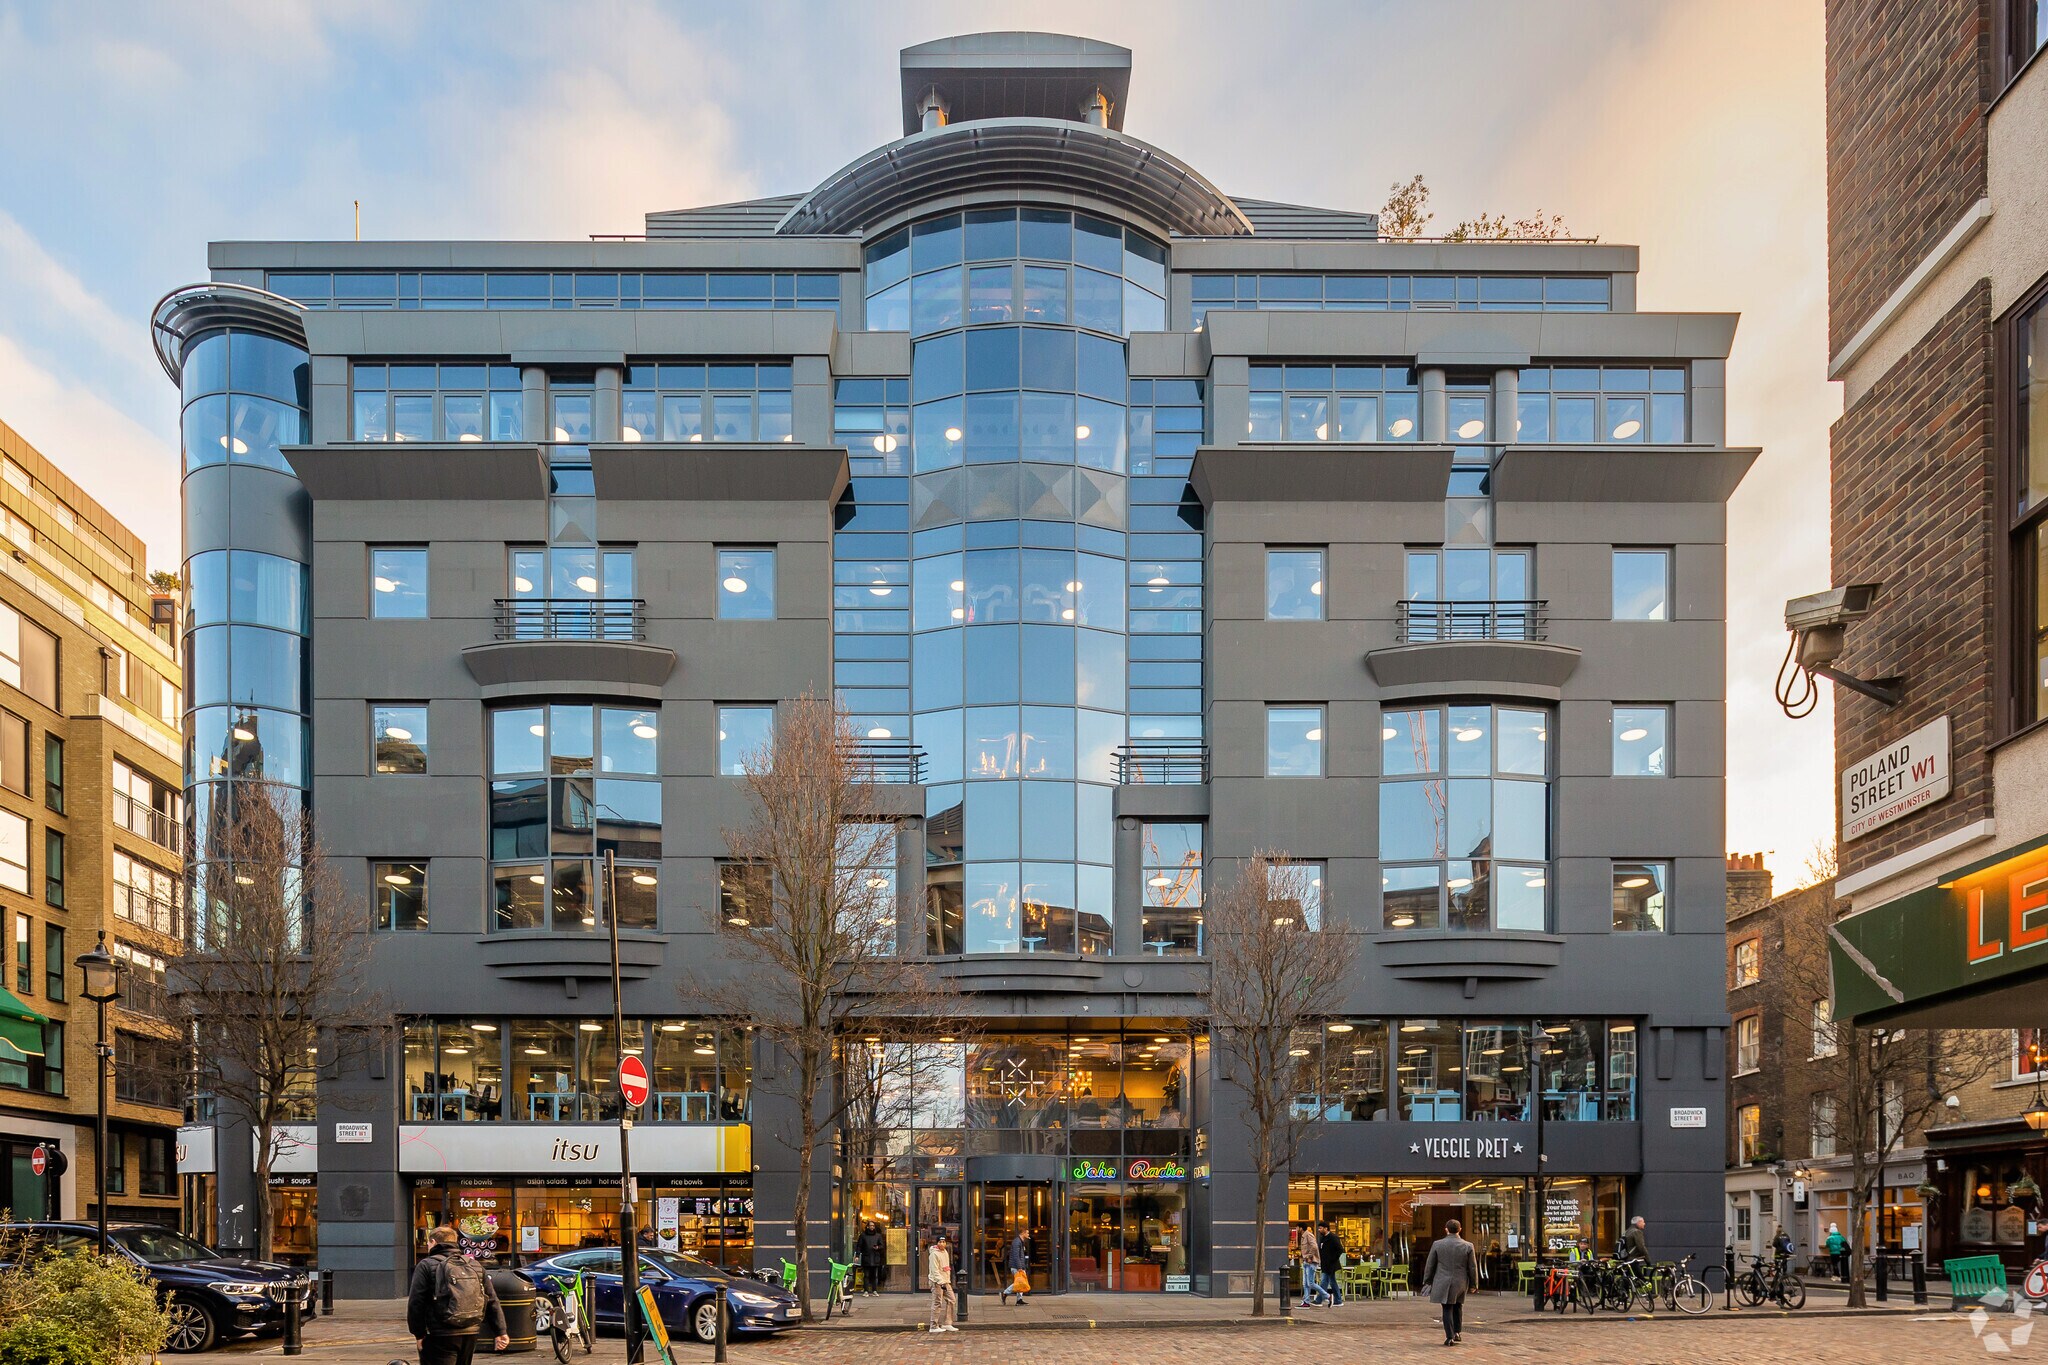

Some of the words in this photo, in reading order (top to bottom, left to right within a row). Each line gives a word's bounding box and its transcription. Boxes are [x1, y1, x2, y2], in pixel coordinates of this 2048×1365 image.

[1851, 745, 1909, 792] POLAND
[1851, 770, 1905, 814] STREET
[1911, 755, 1935, 782] W1
[1851, 821, 1866, 834] CITY
[1868, 815, 1876, 827] OF
[1878, 790, 1931, 821] WESTMINSTER
[552, 1137, 600, 1162] itsu
[1424, 1138, 1470, 1158] VEGGIE
[1477, 1138, 1508, 1158] PRET
[1073, 1160, 1117, 1179] Soho
[1129, 1160, 1185, 1179] Radio
[268, 1176, 284, 1184] sushi
[291, 1177, 311, 1185] soups
[474, 1178, 493, 1186] bowls
[460, 1198, 474, 1208] for
[476, 1198, 496, 1208] free
[1549, 1239, 1563, 1249] £5
